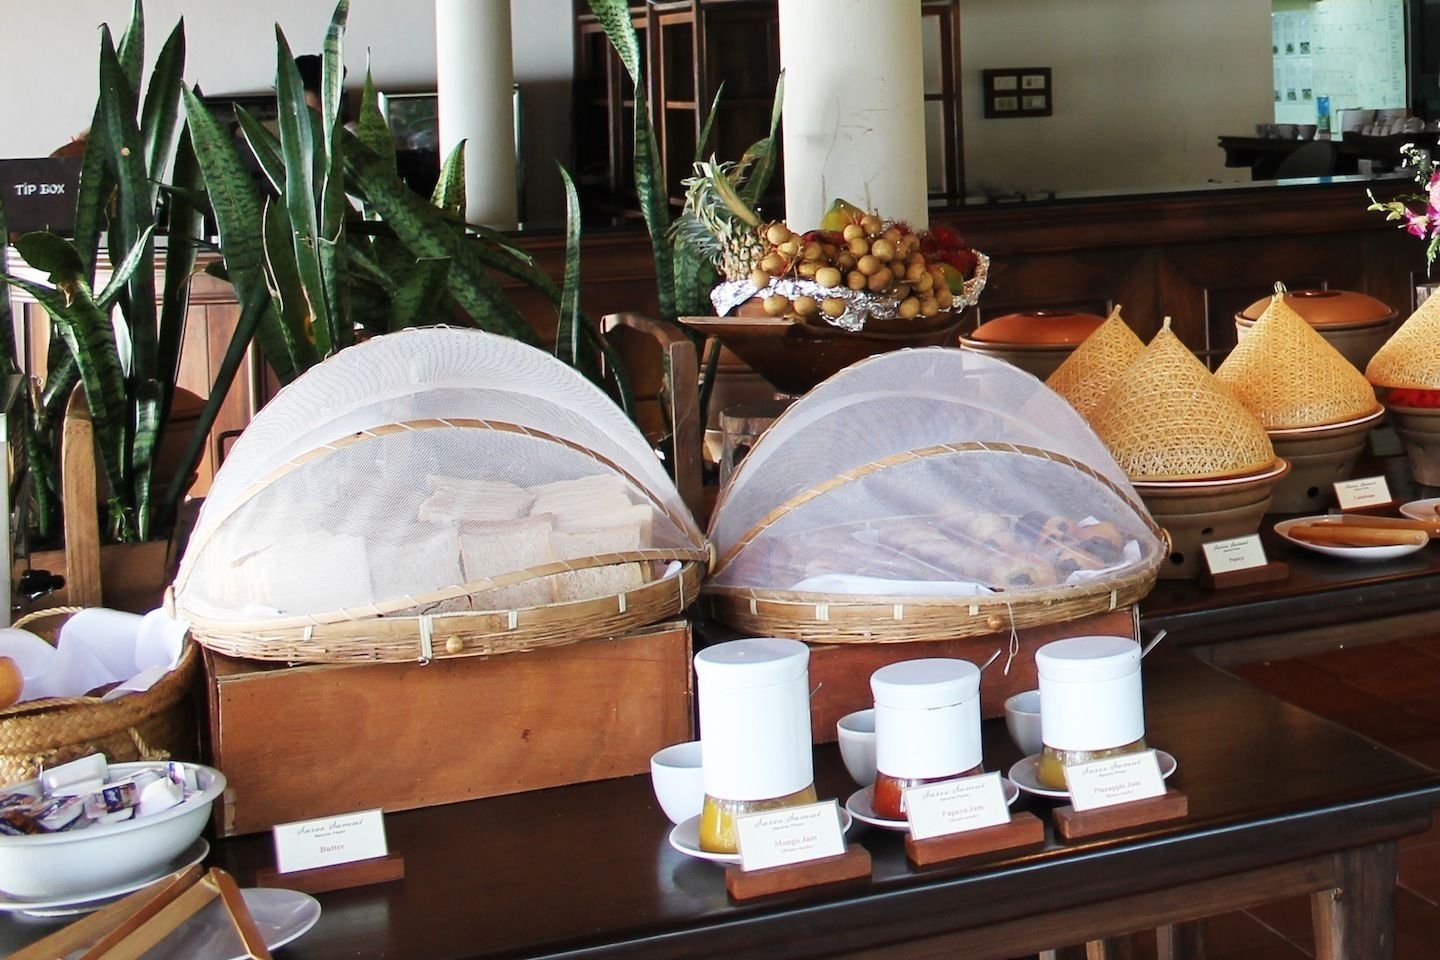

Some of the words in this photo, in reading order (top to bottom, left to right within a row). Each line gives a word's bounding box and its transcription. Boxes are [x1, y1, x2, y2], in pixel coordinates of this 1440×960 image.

[40, 183, 65, 195] BOX
[1093, 783, 1126, 794] Pineapple
[1127, 780, 1141, 788] Jam
[942, 807, 968, 818] Papaya
[969, 804, 985, 812] Jam
[802, 834, 818, 842] Jam
[320, 843, 345, 853] Butter
